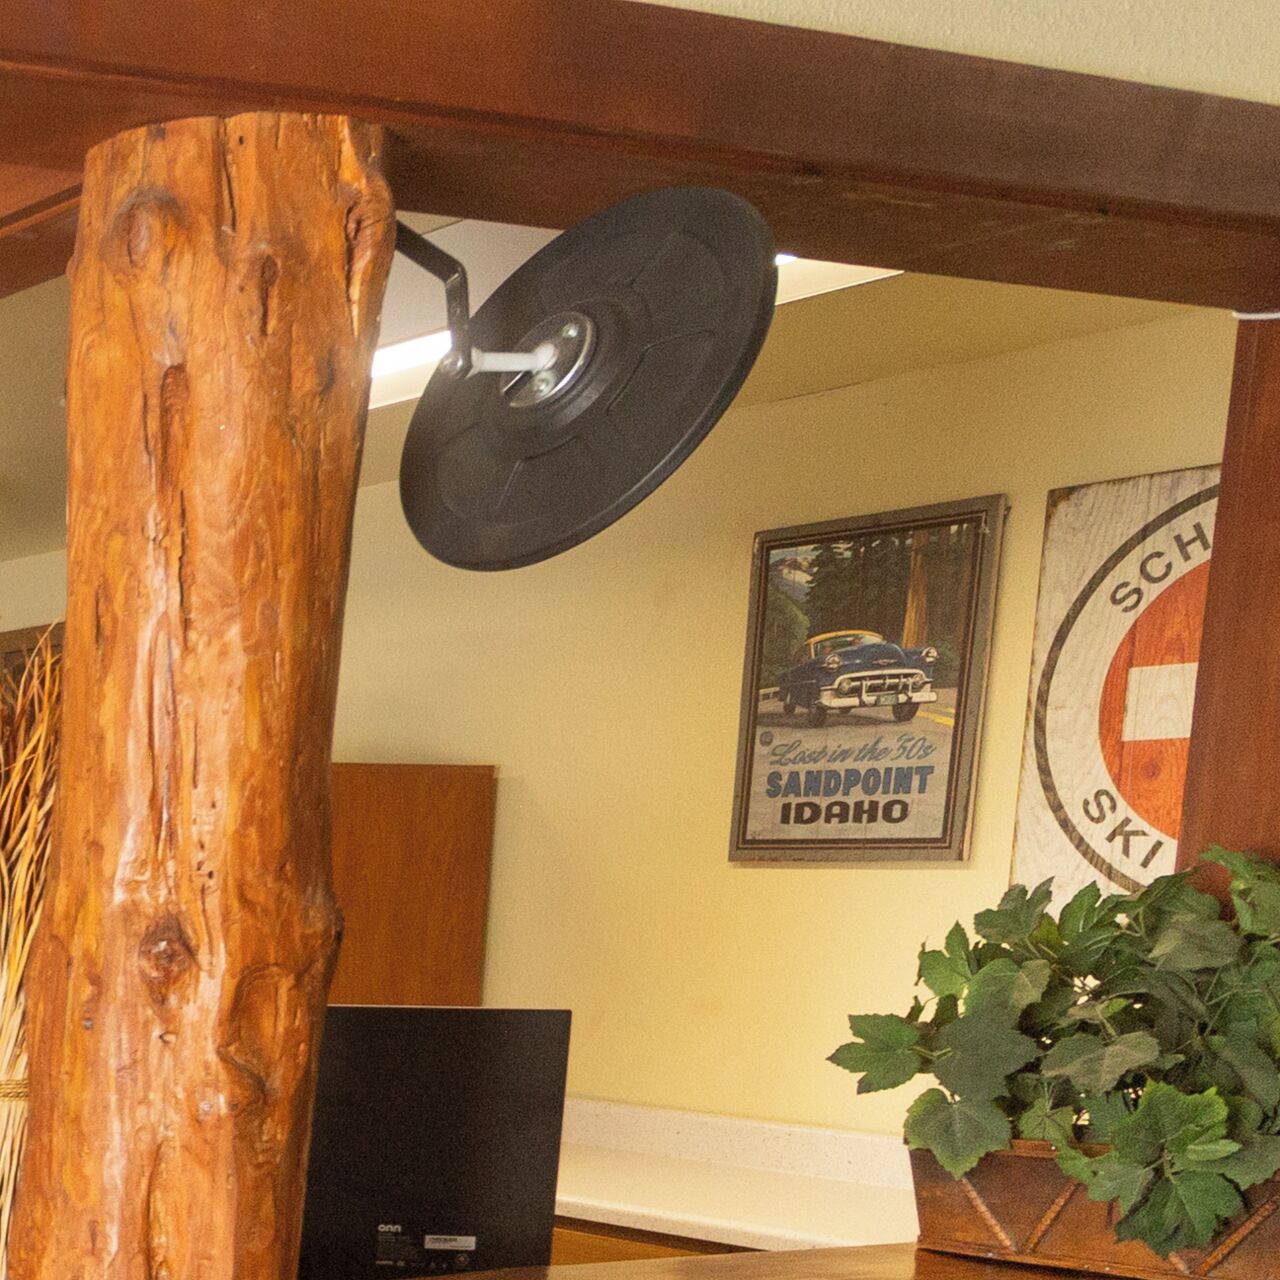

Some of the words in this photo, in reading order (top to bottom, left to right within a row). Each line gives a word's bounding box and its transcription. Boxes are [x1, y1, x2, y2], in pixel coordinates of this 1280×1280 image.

[769, 740, 826, 766] Lost
[827, 743, 853, 763] in
[853, 736, 892, 762] the
[765, 765, 935, 798] SANDPOINT
[780, 799, 910, 825] IDAHO
[1082, 788, 1165, 869] SKI
